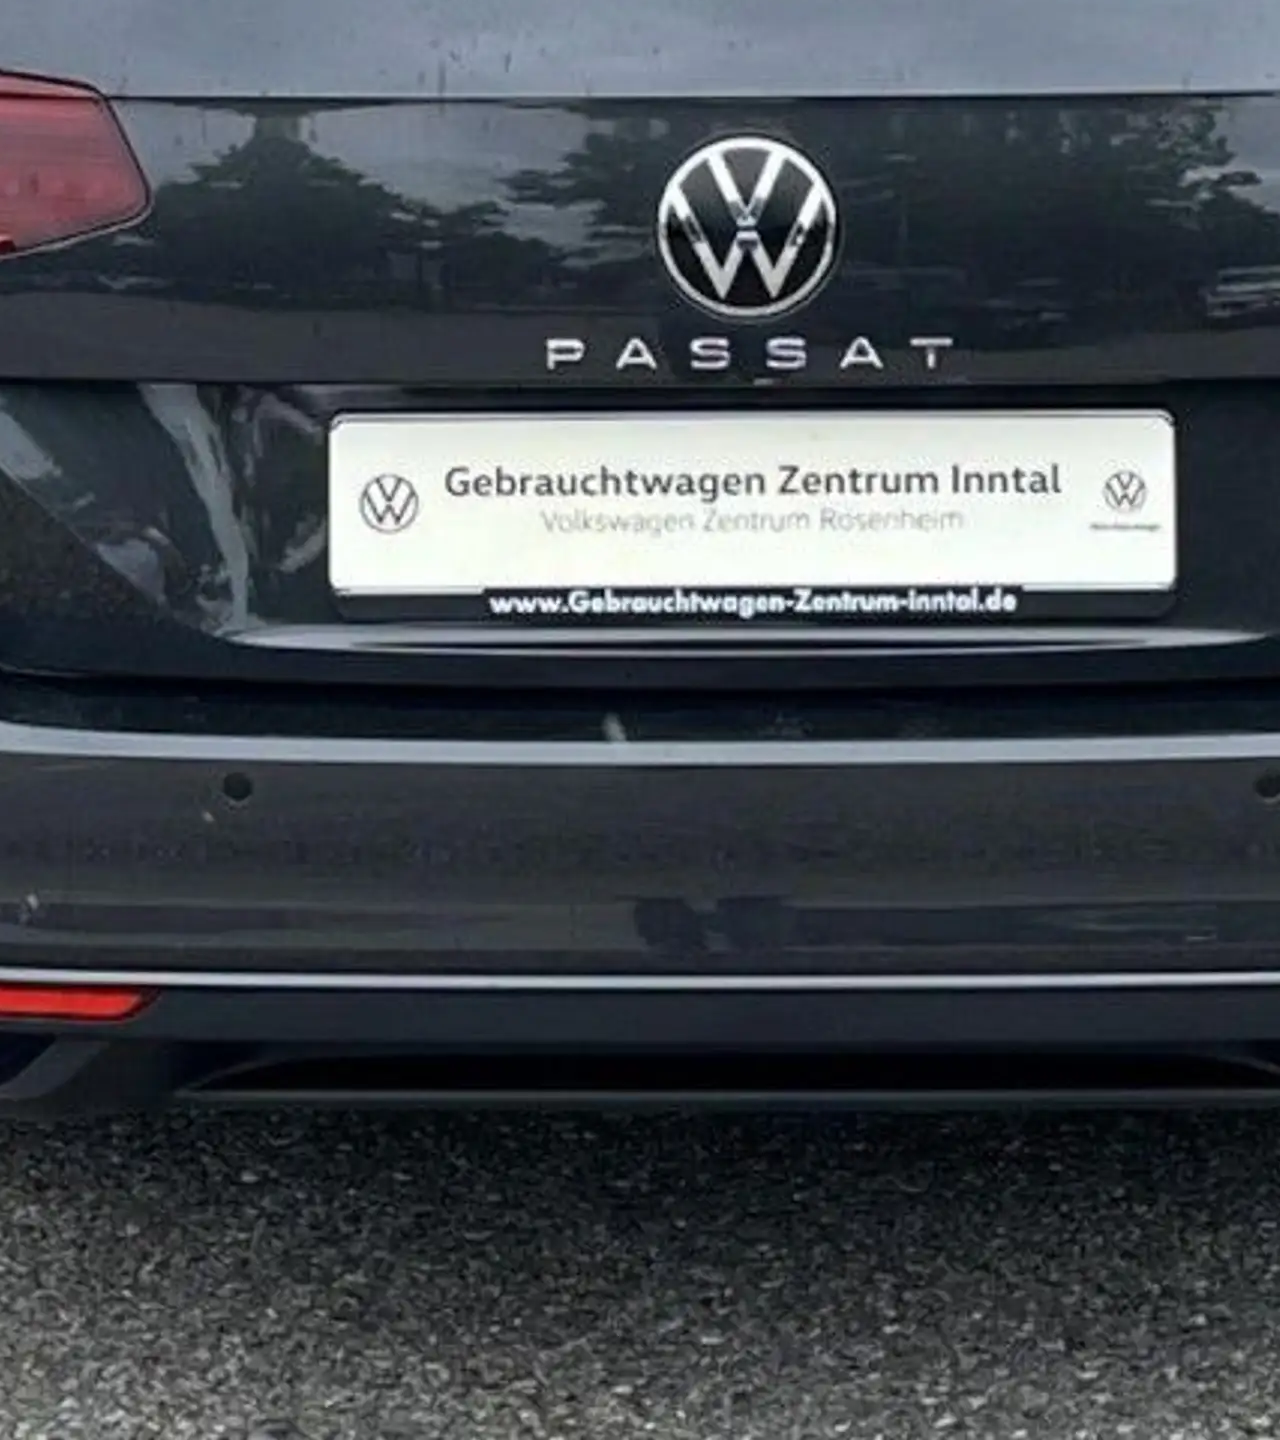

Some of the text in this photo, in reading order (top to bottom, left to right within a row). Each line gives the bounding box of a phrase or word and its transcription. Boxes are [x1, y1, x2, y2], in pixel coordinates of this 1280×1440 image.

[545, 336, 954, 371] PASSAT
[442, 460, 1065, 504] Gebrauchtwagen Zentrum Inntal
[540, 508, 966, 538] Volkswagen Zentrum Rosenheim
[488, 586, 1020, 622] www.Gebrauchtwagen-Zentrum-inntal.de
